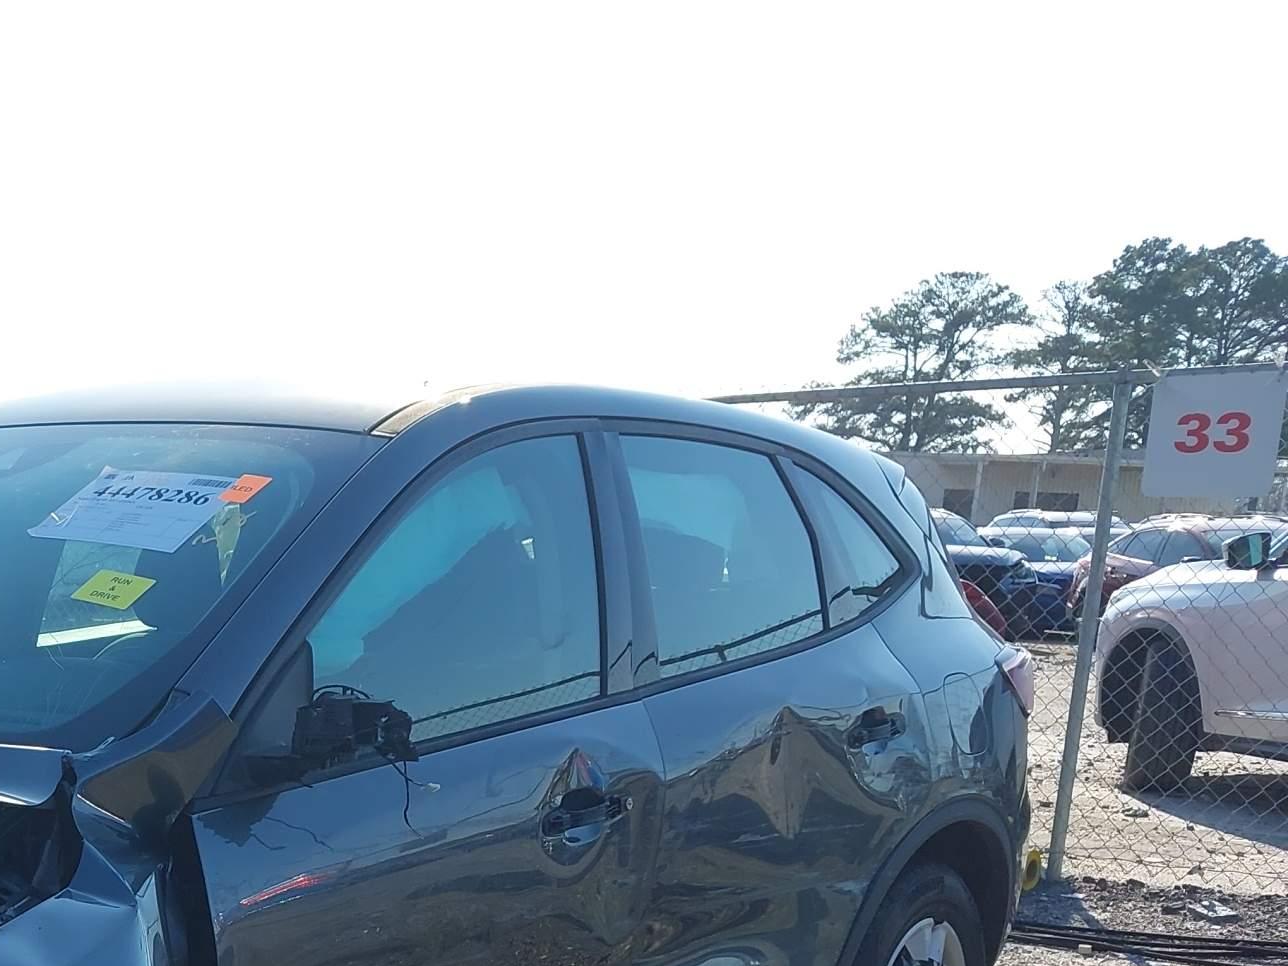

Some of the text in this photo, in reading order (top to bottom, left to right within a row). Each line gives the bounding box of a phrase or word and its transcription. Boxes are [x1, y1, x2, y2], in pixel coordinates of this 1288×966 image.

[1173, 411, 1253, 454] 33
[92, 485, 217, 506] 44478286
[110, 576, 133, 586] RUN
[89, 590, 121, 601] DRIVE
